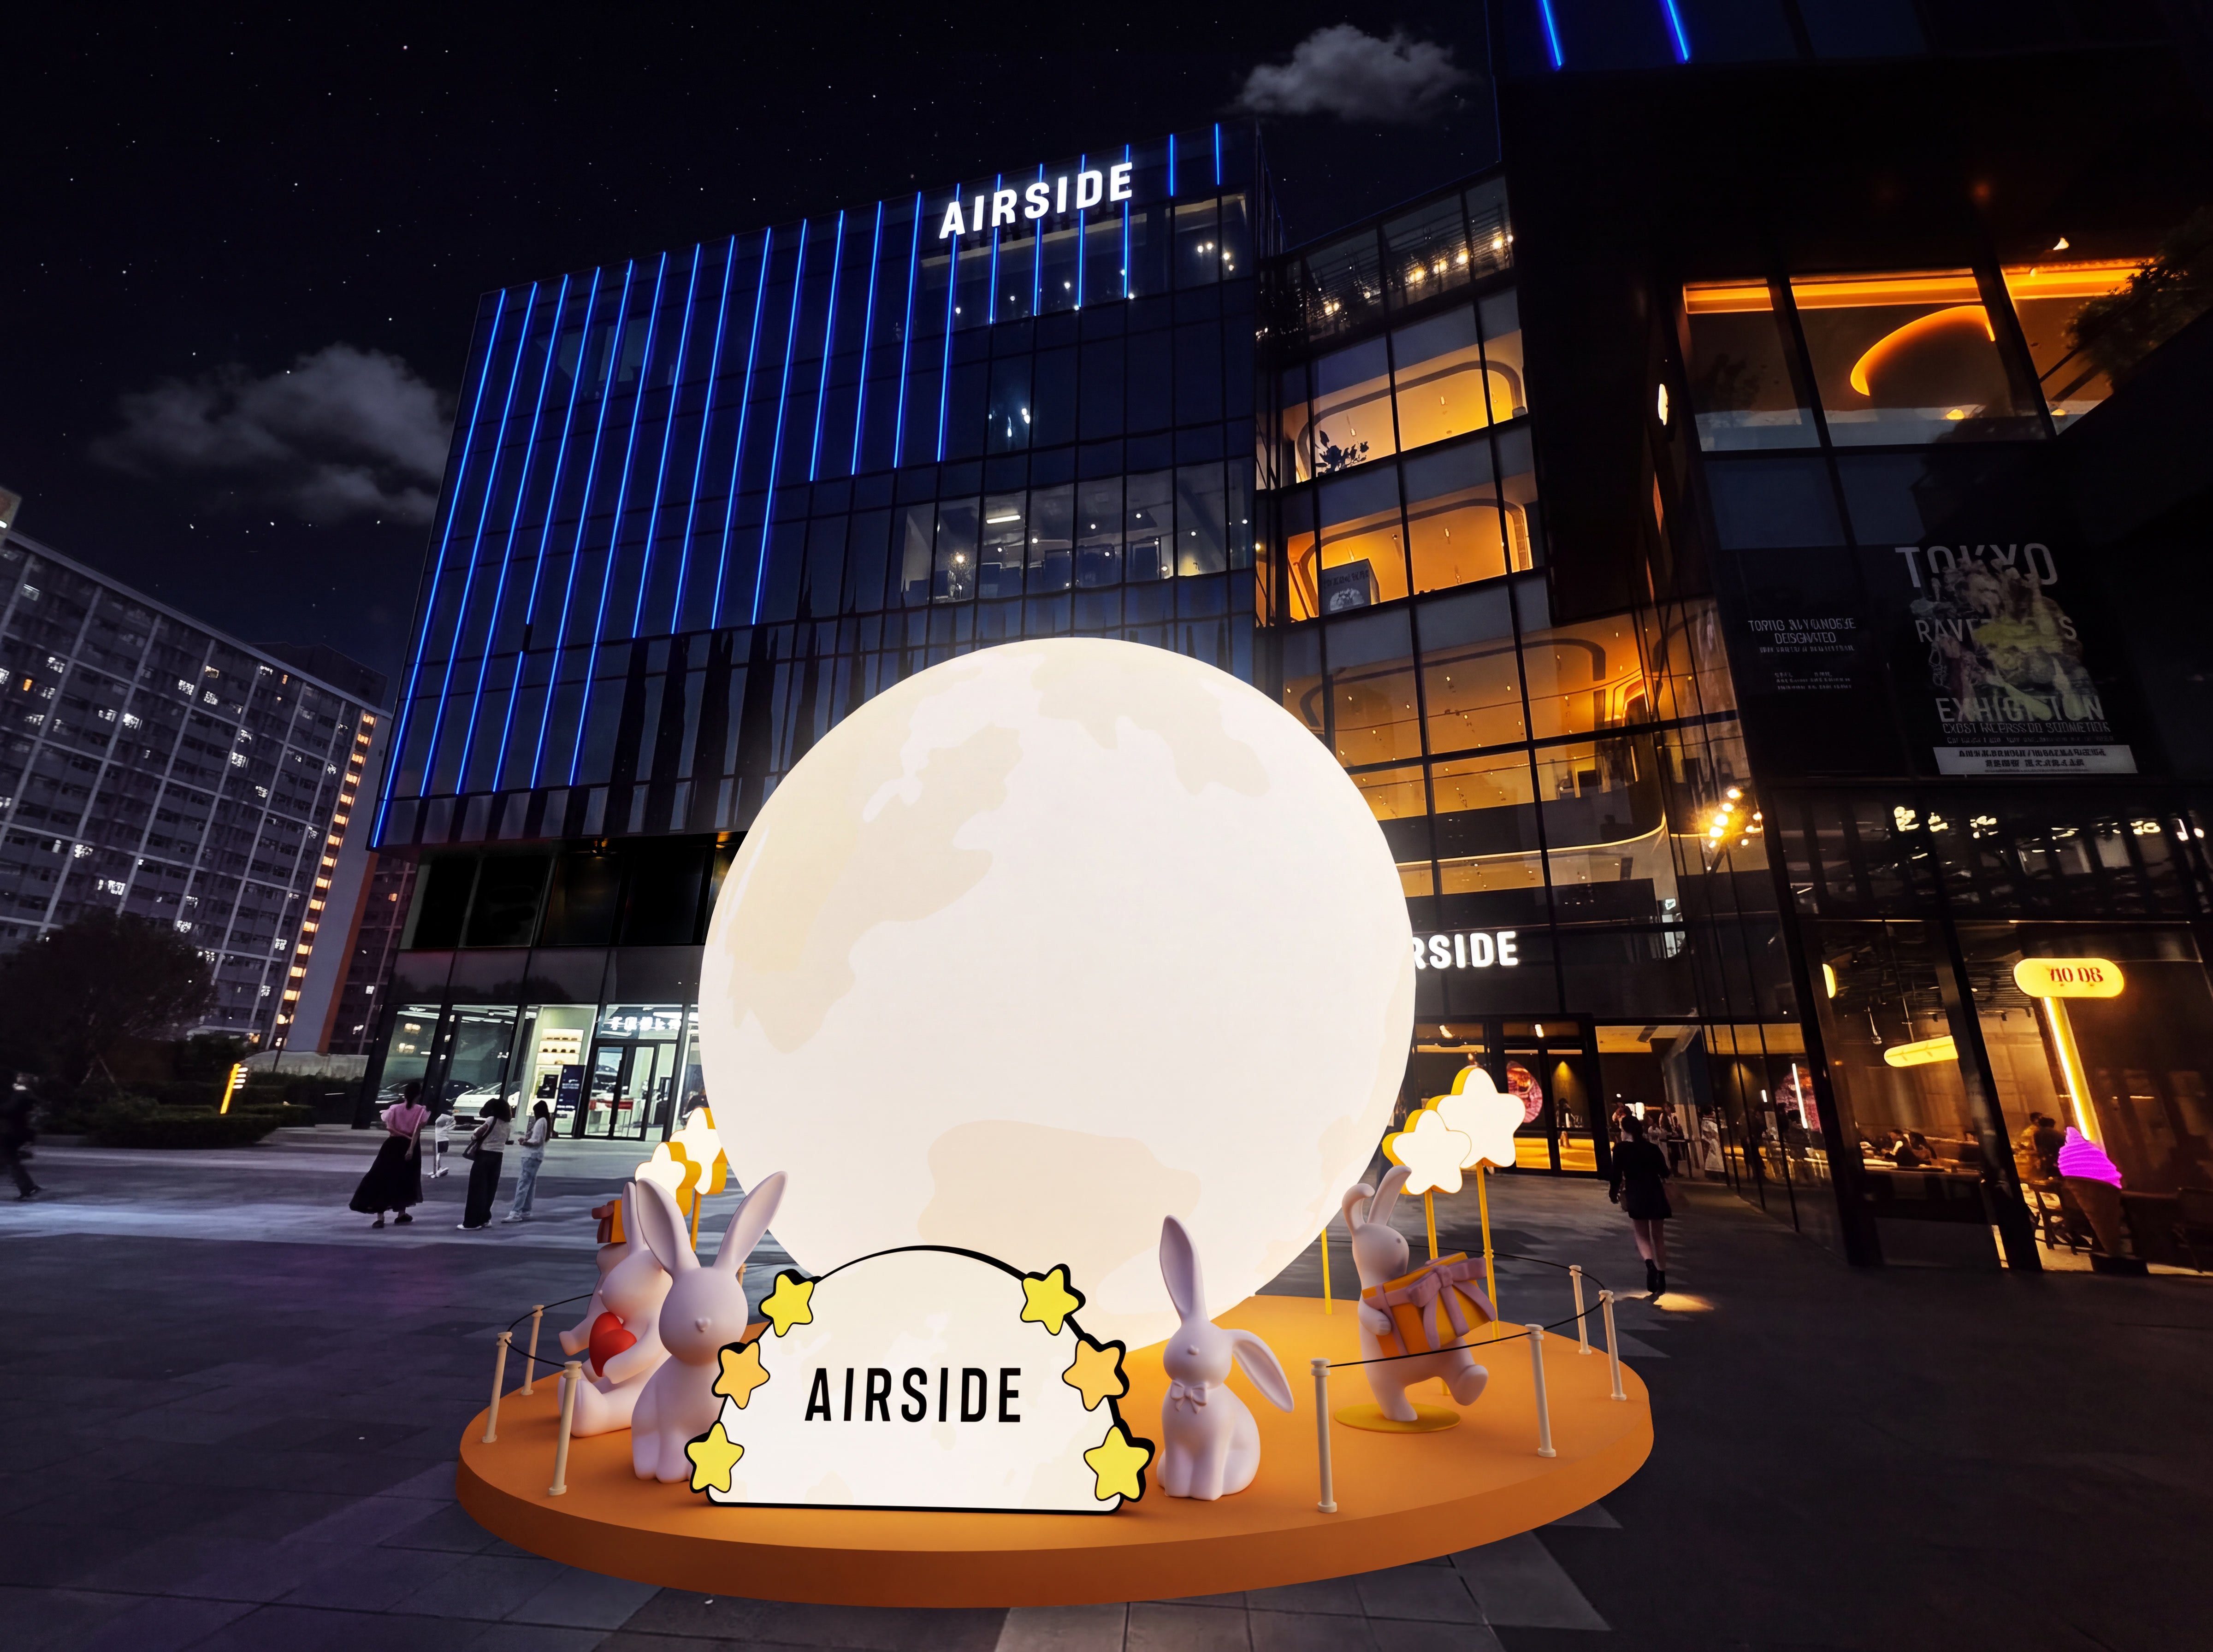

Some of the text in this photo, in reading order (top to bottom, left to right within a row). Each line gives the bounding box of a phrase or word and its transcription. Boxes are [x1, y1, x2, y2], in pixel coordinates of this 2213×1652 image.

[939, 162, 1133, 239] AIRSIDE
[1413, 931, 1518, 969] RSIDE
[805, 1367, 1020, 1422] AIRSIDE
